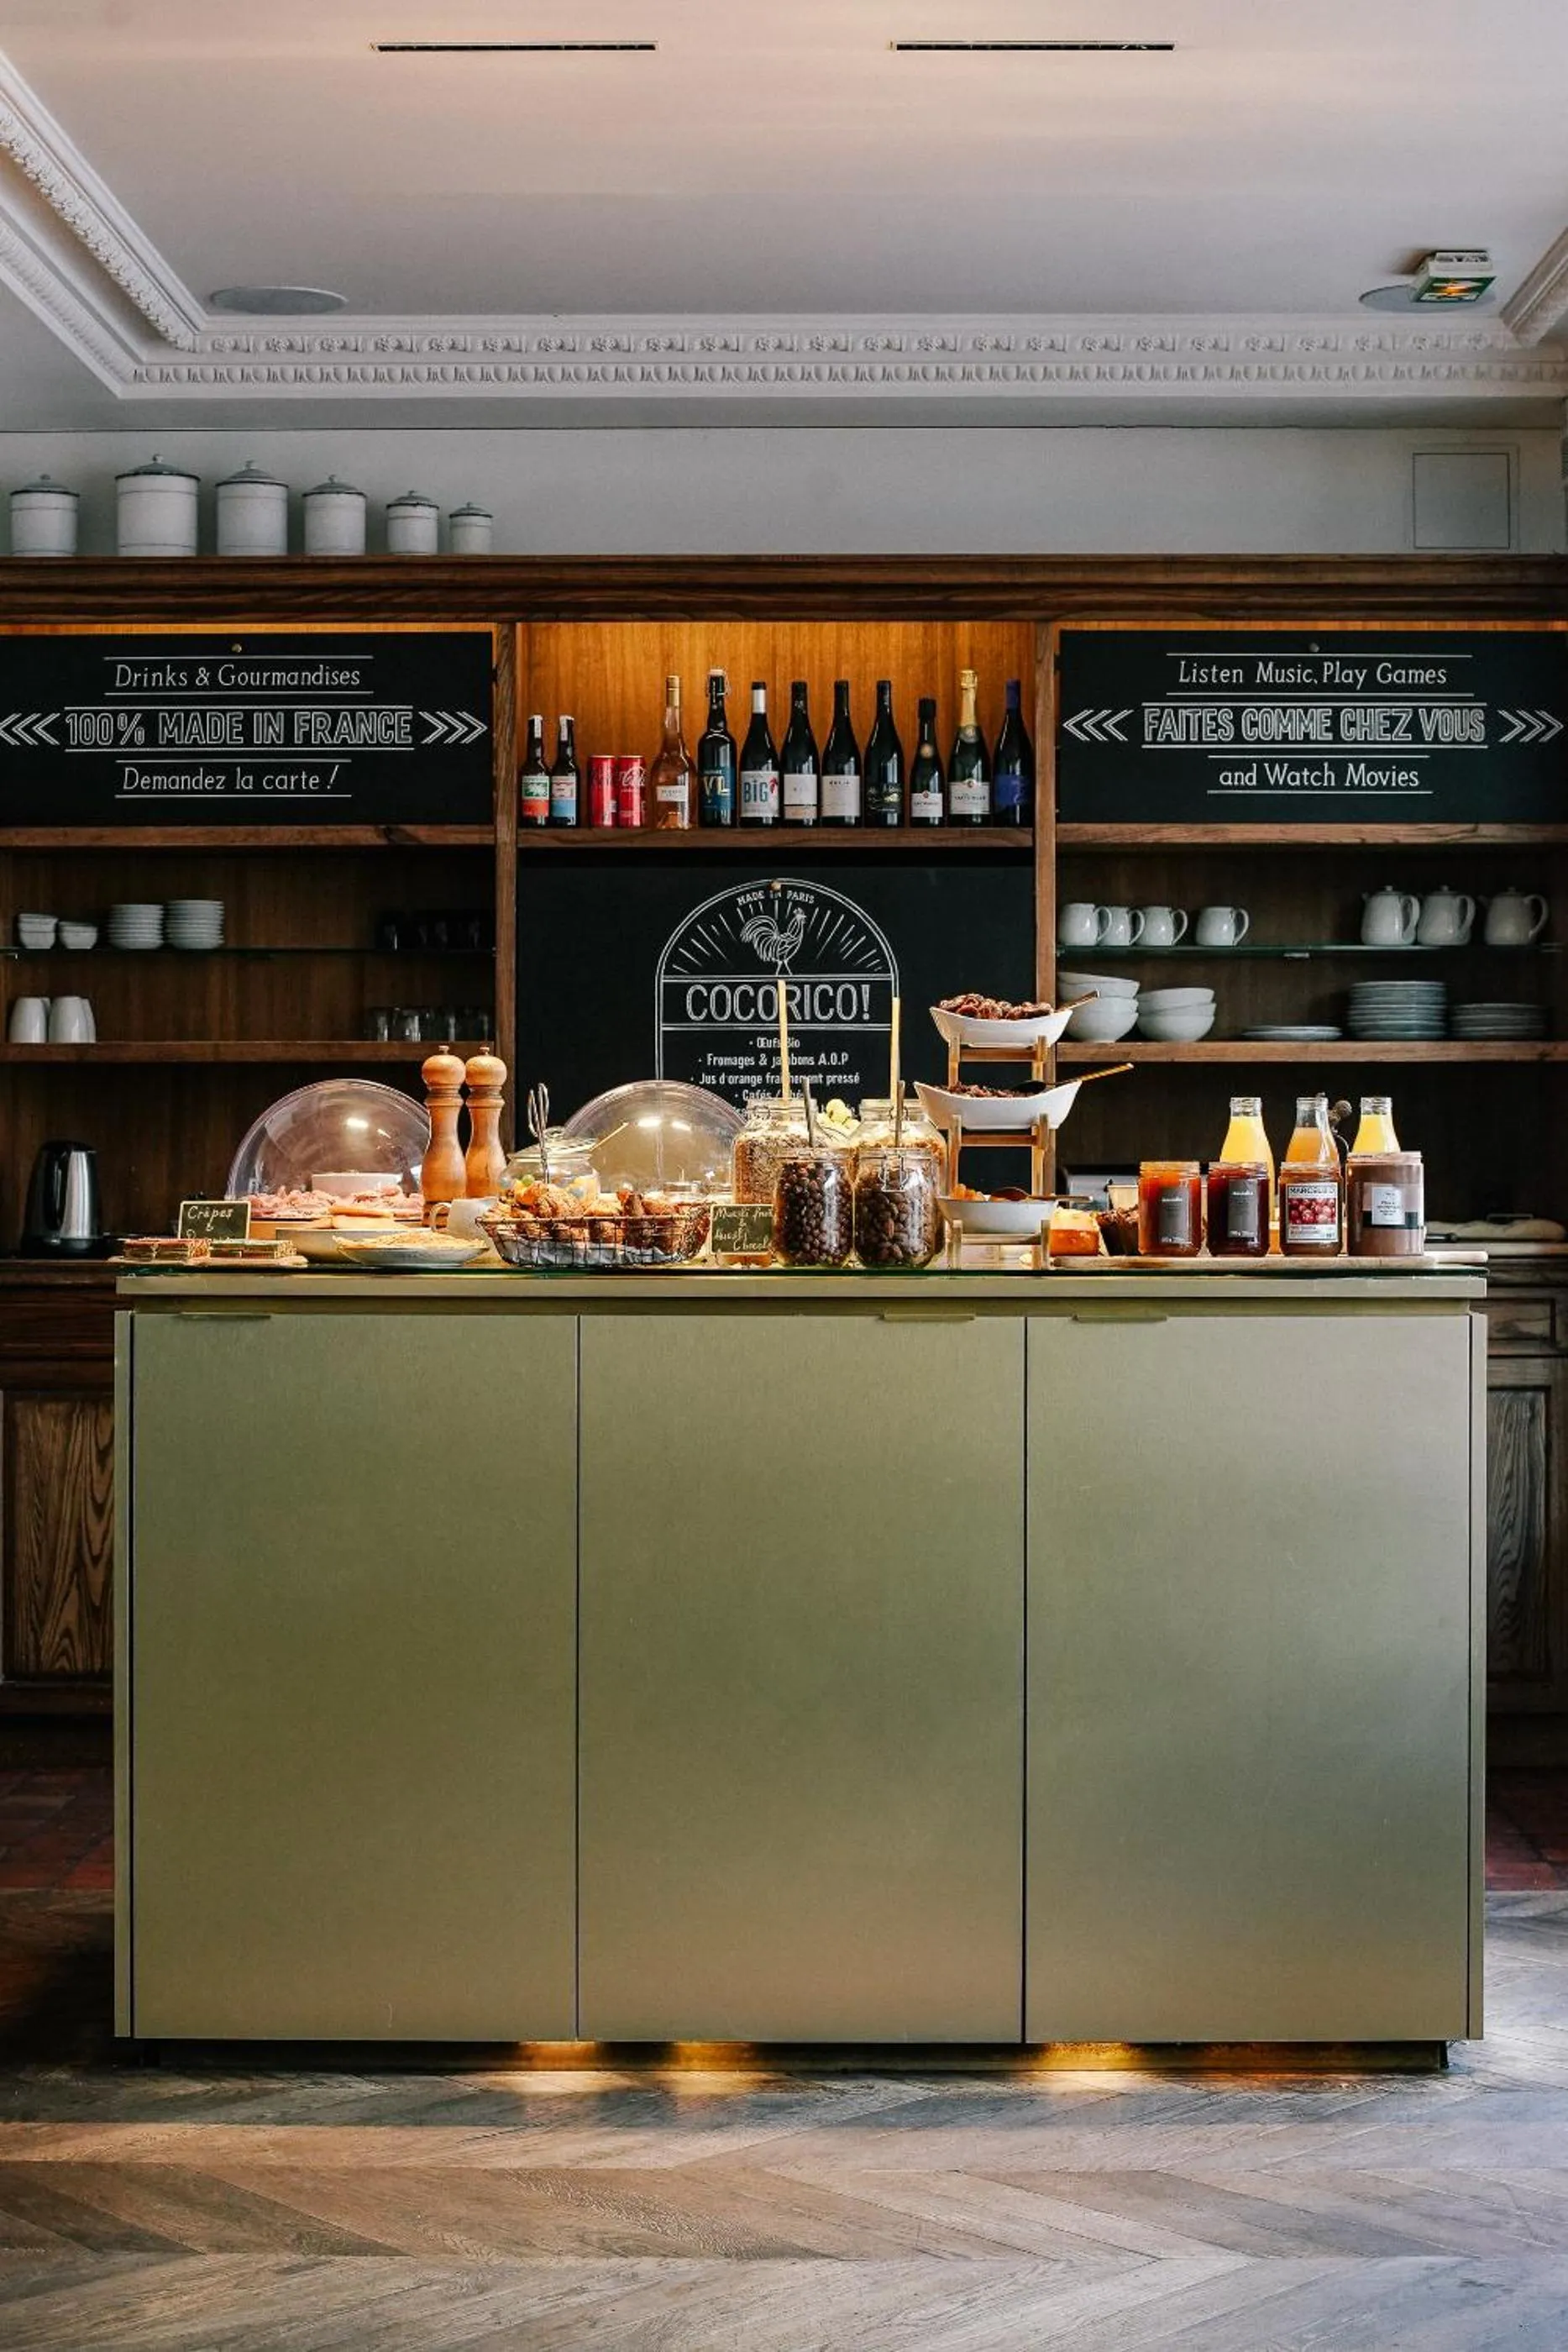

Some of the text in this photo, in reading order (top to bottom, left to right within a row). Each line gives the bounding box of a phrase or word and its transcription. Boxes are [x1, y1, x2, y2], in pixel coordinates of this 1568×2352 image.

[115, 664, 360, 687] Drinks & Gourmandises
[1178, 660, 1243, 684] Listen
[1323, 660, 1367, 690] Play
[1376, 662, 1447, 685] Games
[66, 711, 413, 745] 100% MADE IN FRANCE
[1144, 707, 1486, 743] FAITES COMME CHEZ VOUS
[123, 767, 226, 790] Demandez
[235, 766, 254, 790] la
[262, 770, 320, 790] carte
[1219, 761, 1420, 787] and Watch Movies
[737, 890, 765, 906] MADE
[787, 890, 815, 904] PARIS
[685, 983, 871, 1021] COCORICO!
[706, 1053, 755, 1069] Fromages
[758, 1053, 768, 1065] &
[771, 1053, 815, 1068] jabons
[699, 1073, 716, 1084] Jus
[826, 1072, 860, 1086] pressé
